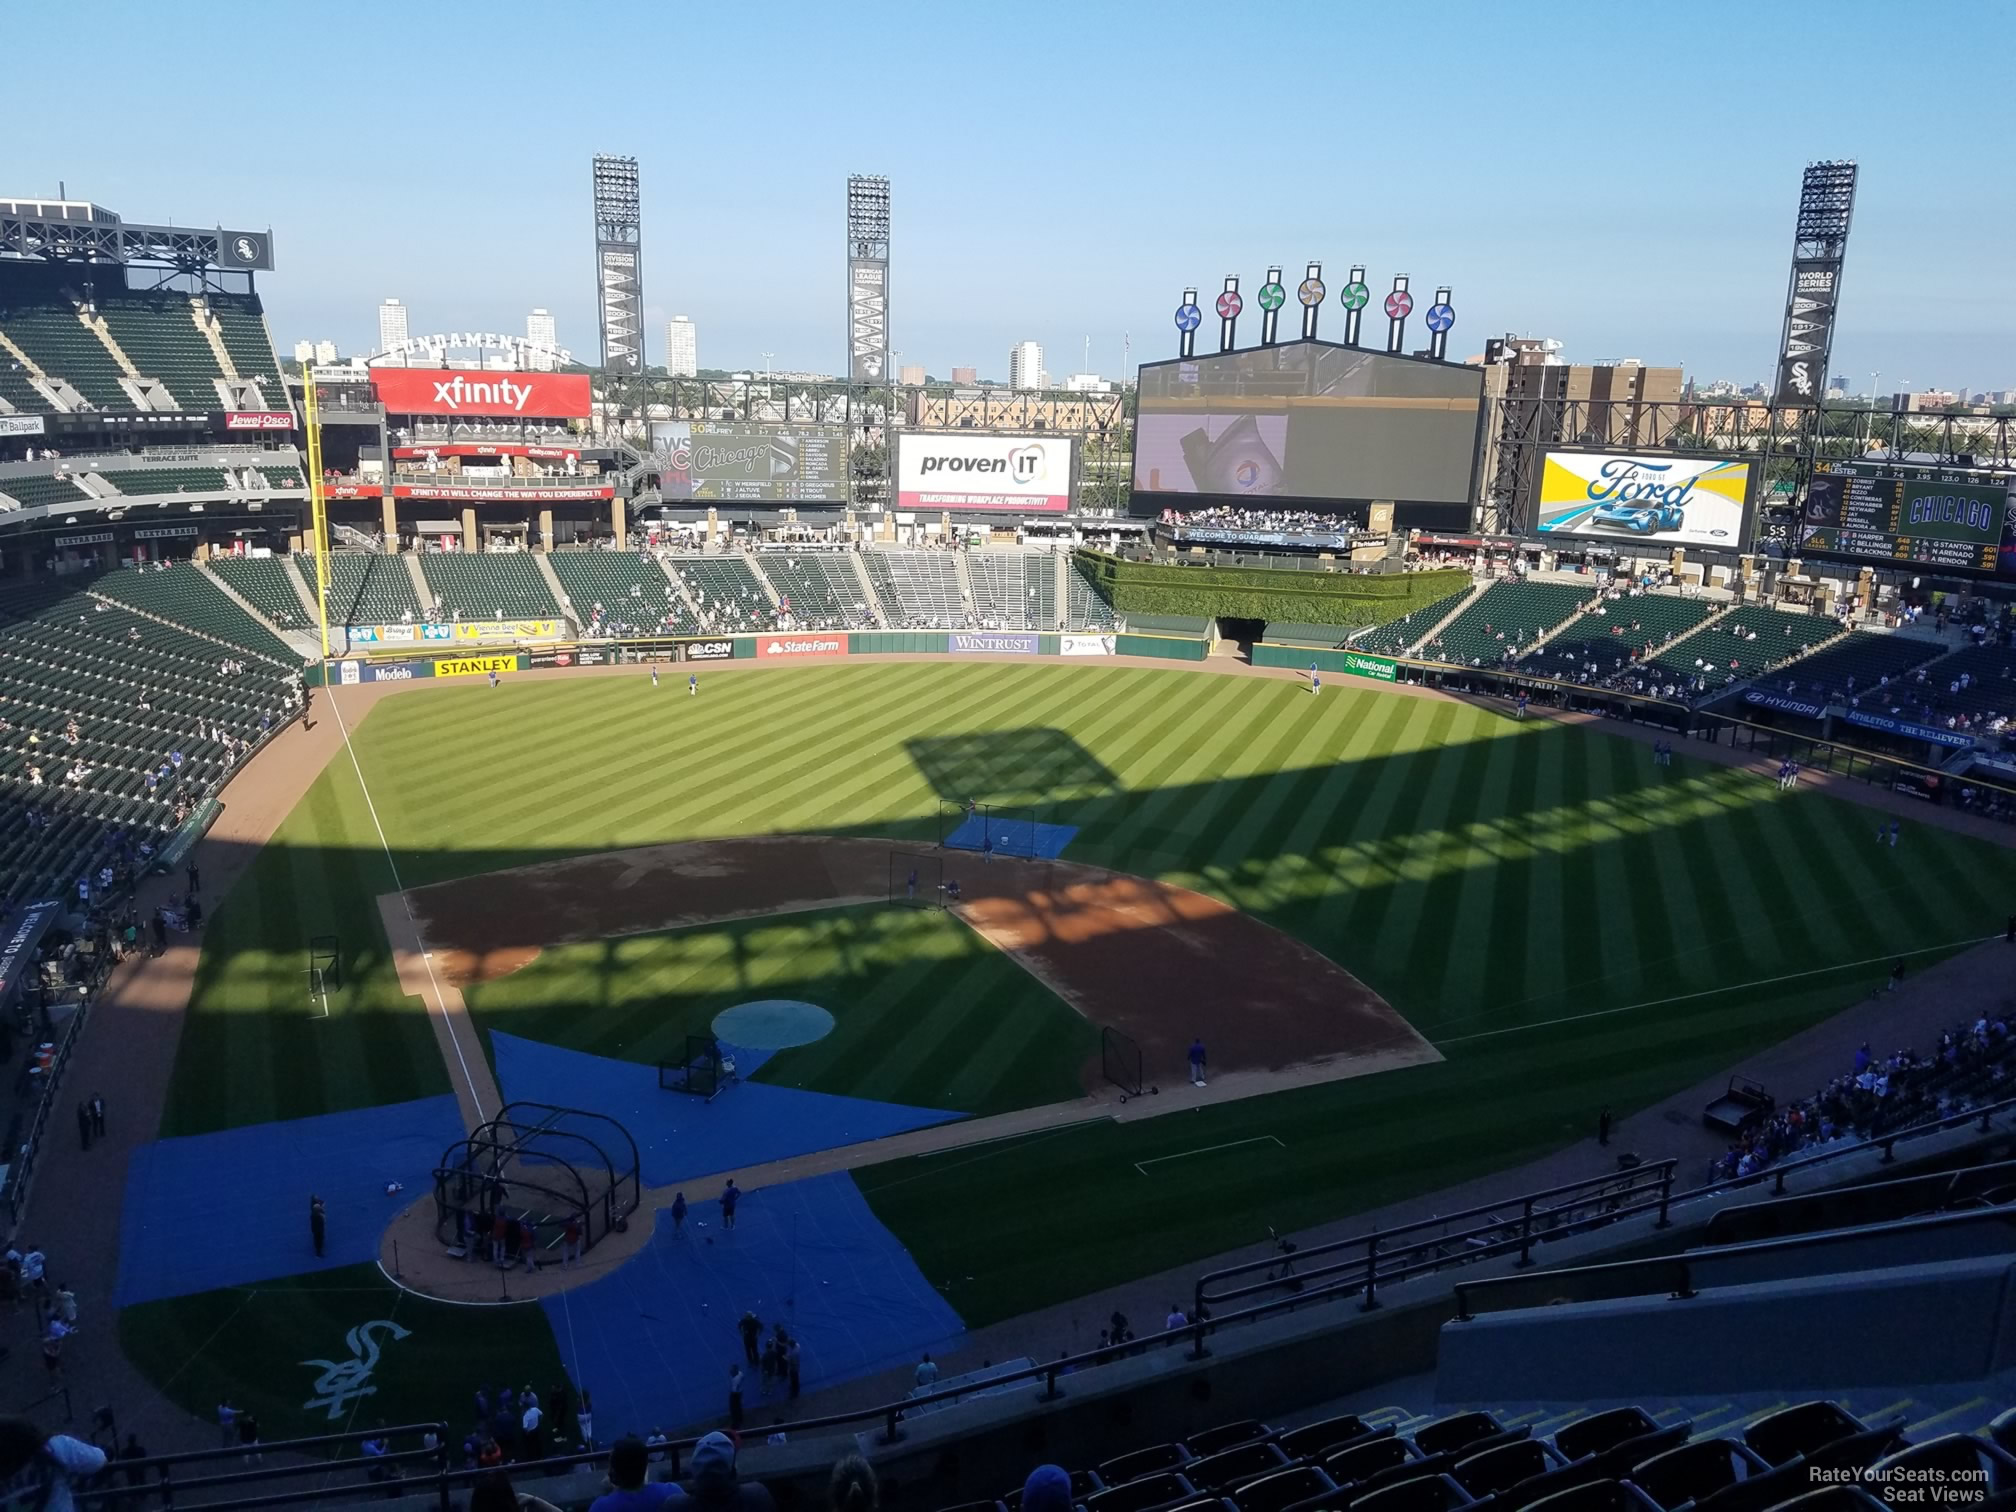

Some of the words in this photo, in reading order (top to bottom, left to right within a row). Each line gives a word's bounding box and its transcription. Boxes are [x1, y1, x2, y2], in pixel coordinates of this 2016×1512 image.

[855, 273, 883, 281] LEAGUE
[1798, 272, 1833, 280] WORLD
[1798, 280, 1832, 288] SERIES
[433, 376, 533, 410] xfinity
[229, 414, 291, 426] Jewel-Osco
[9, 421, 40, 432] Ballpark
[691, 424, 705, 434] 50
[477, 447, 496, 455] xfinity
[178, 454, 199, 462] SUITE
[693, 443, 770, 473] Chicago
[920, 456, 1006, 475] proven
[1018, 456, 1038, 474] IT
[1814, 462, 1830, 472] 34
[1830, 467, 1858, 475] LESTER
[1586, 459, 1700, 507] Ford
[335, 486, 358, 496] xfinity
[471, 490, 503, 498] CHANGE
[504, 490, 521, 498] THE
[522, 490, 538, 498] WAY
[538, 490, 553, 498] YOU
[554, 490, 593, 498] EXPERIENCE
[920, 494, 966, 504] TRANSFORMING
[966, 495, 1004, 505] WORKPLACE
[1004, 496, 1048, 506] PRODUCTIVITY
[1909, 496, 1992, 532] CHICAGO
[91, 534, 112, 542] BASE
[143, 529, 172, 538] EXTRA
[1858, 533, 1884, 541] HARPER
[1857, 540, 1892, 550] BELLINGER
[1940, 542, 1974, 551] STANTON
[1856, 547, 1892, 556] BLACKMON
[1939, 549, 1974, 559] ARENADO
[1938, 557, 1968, 565] RENDON
[704, 642, 732, 653] CSN
[955, 635, 1031, 650] WINTRUST
[530, 655, 557, 664] guaranteed
[441, 659, 511, 674] STANLEY
[1356, 658, 1394, 673] National
[376, 667, 412, 681] Modelo
[1765, 697, 1818, 716] HYUNDAI
[1849, 711, 1894, 728] ATHLETICO
[1900, 724, 1917, 735] THE
[1919, 728, 1971, 746] RELIEVERS
[10, 912, 42, 944] WELCOME
[4, 944, 22, 954] TO
